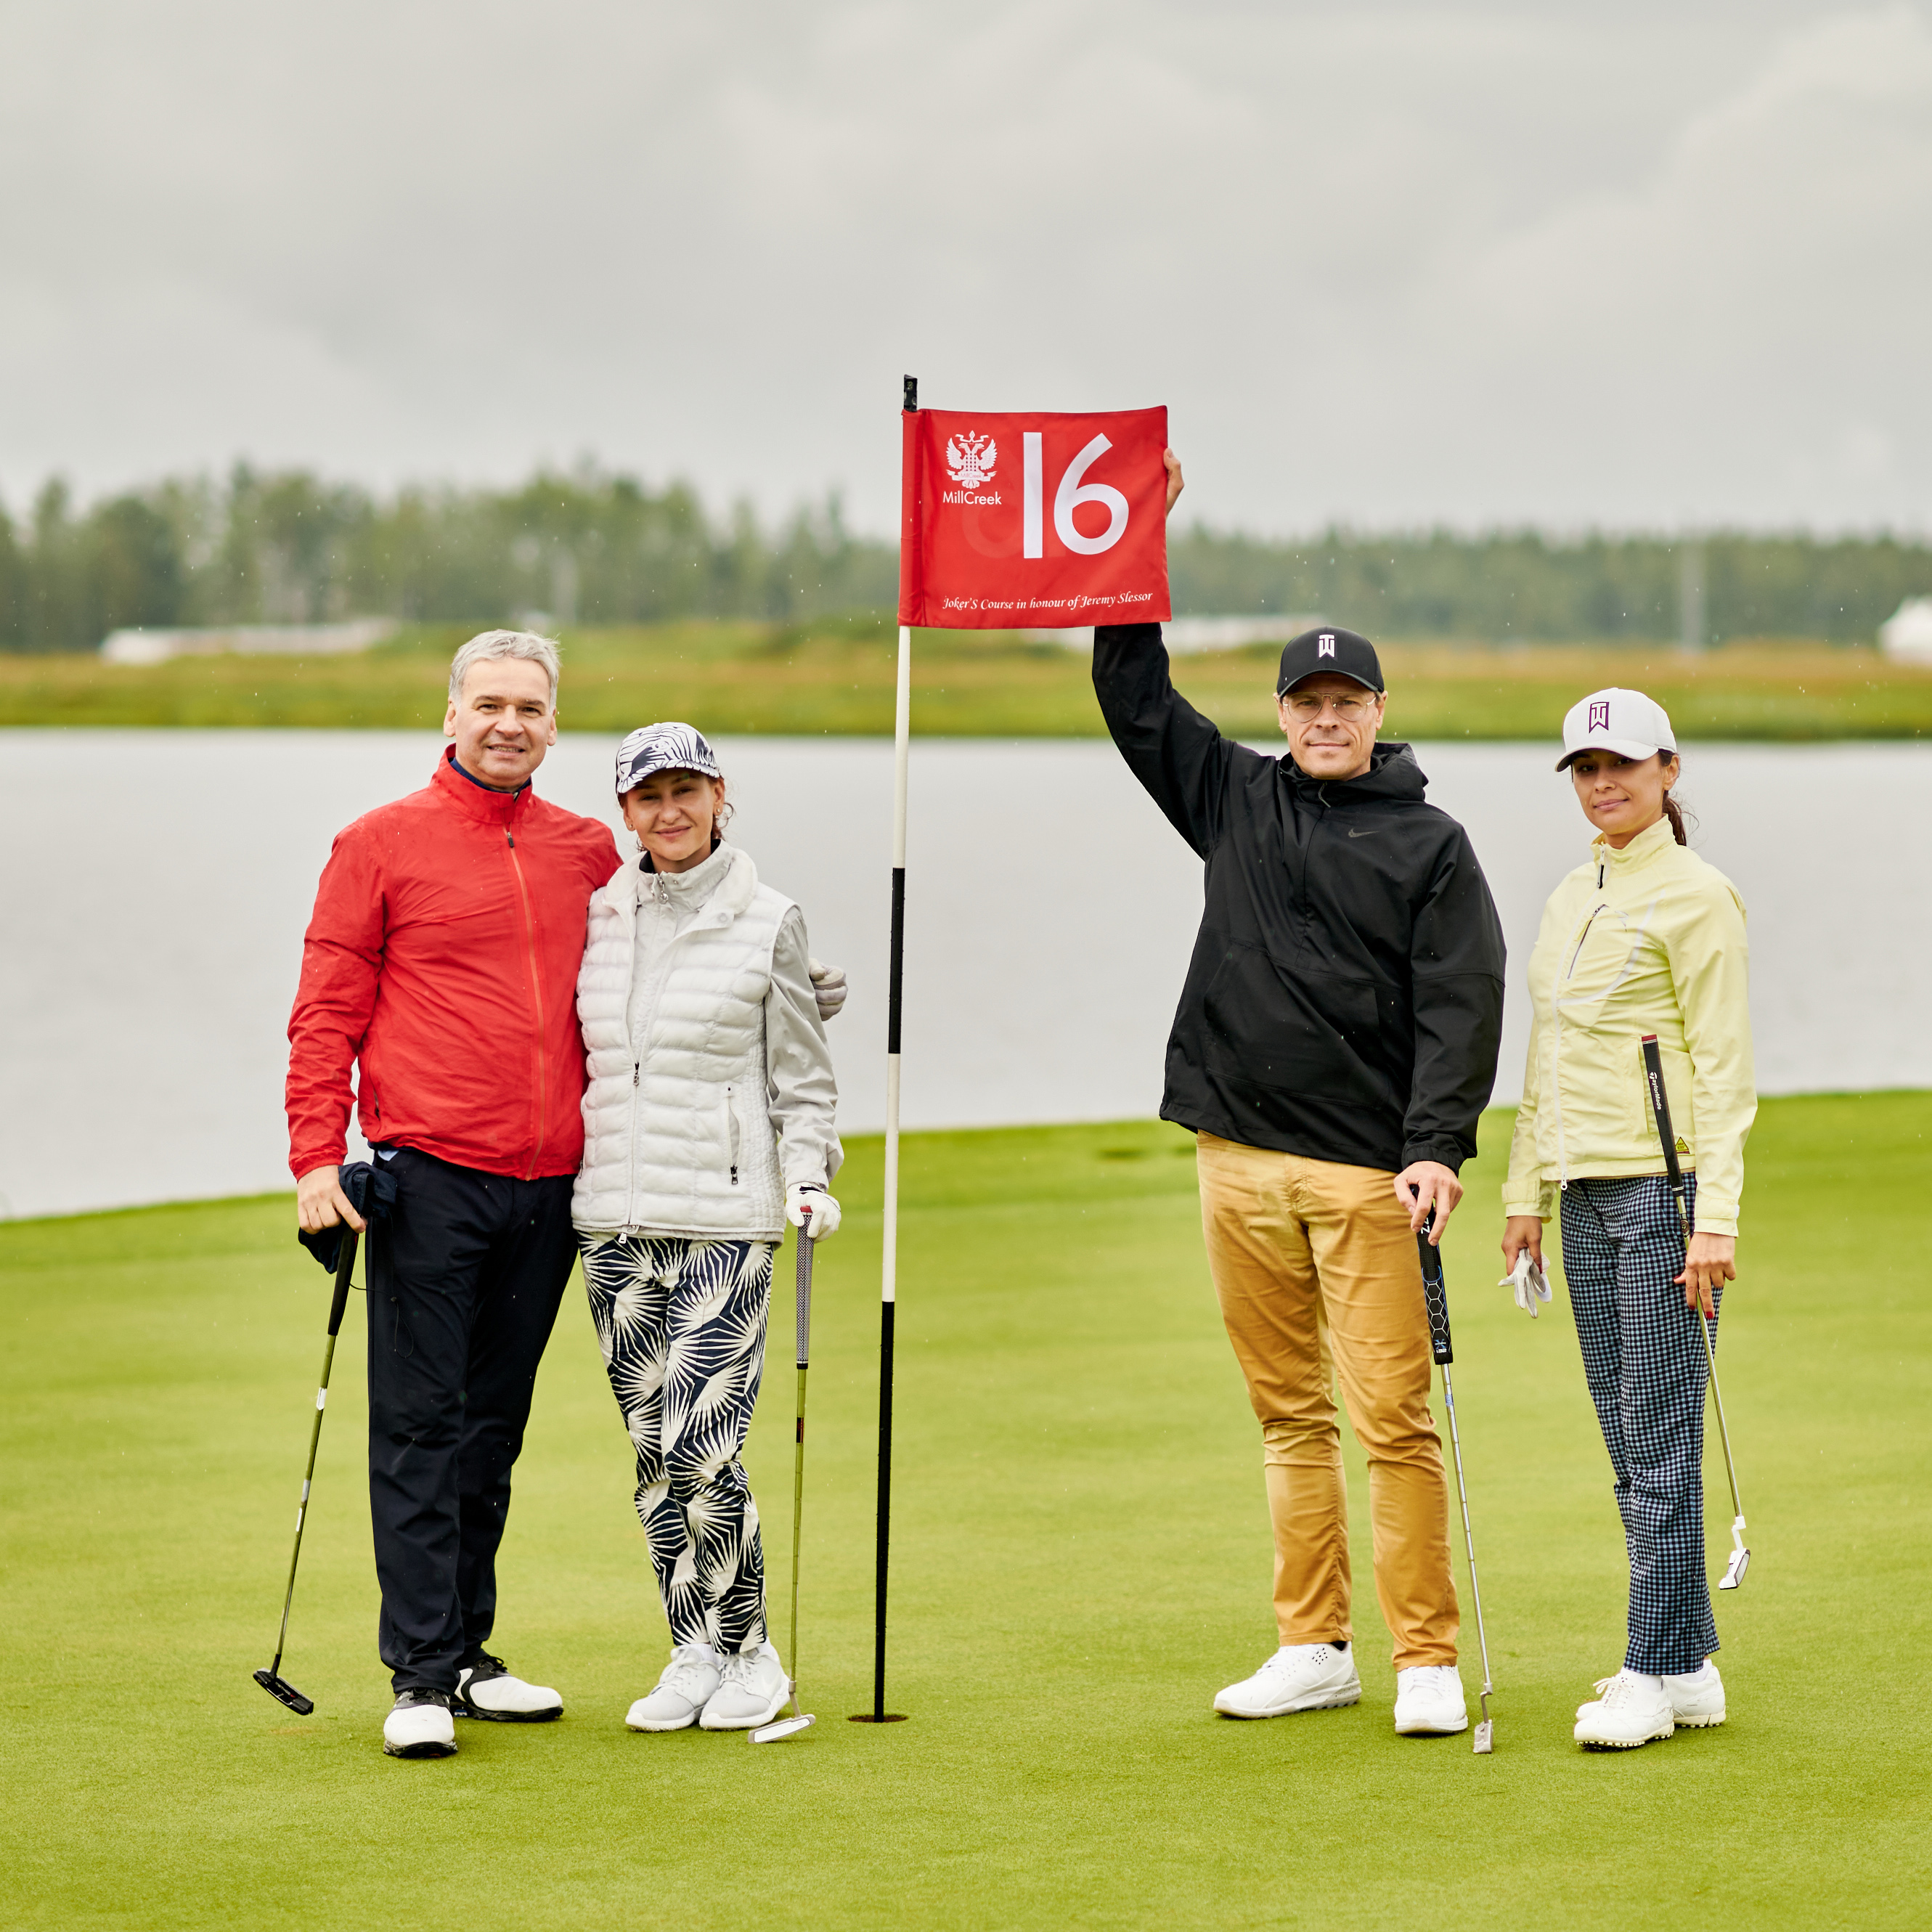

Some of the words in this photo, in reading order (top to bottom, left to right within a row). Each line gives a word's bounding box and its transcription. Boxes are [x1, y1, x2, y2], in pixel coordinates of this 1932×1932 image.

[942, 490, 1002, 505] MillCreek
[1023, 431, 1130, 559] 16
[980, 599, 1014, 609] Course
[1016, 599, 1027, 609] in
[1030, 598, 1066, 608] honour
[1067, 595, 1081, 610] of
[1080, 595, 1116, 608] Jeremy
[1117, 591, 1153, 603] Slessor
[1649, 1072, 1662, 1110] TaylorMade
